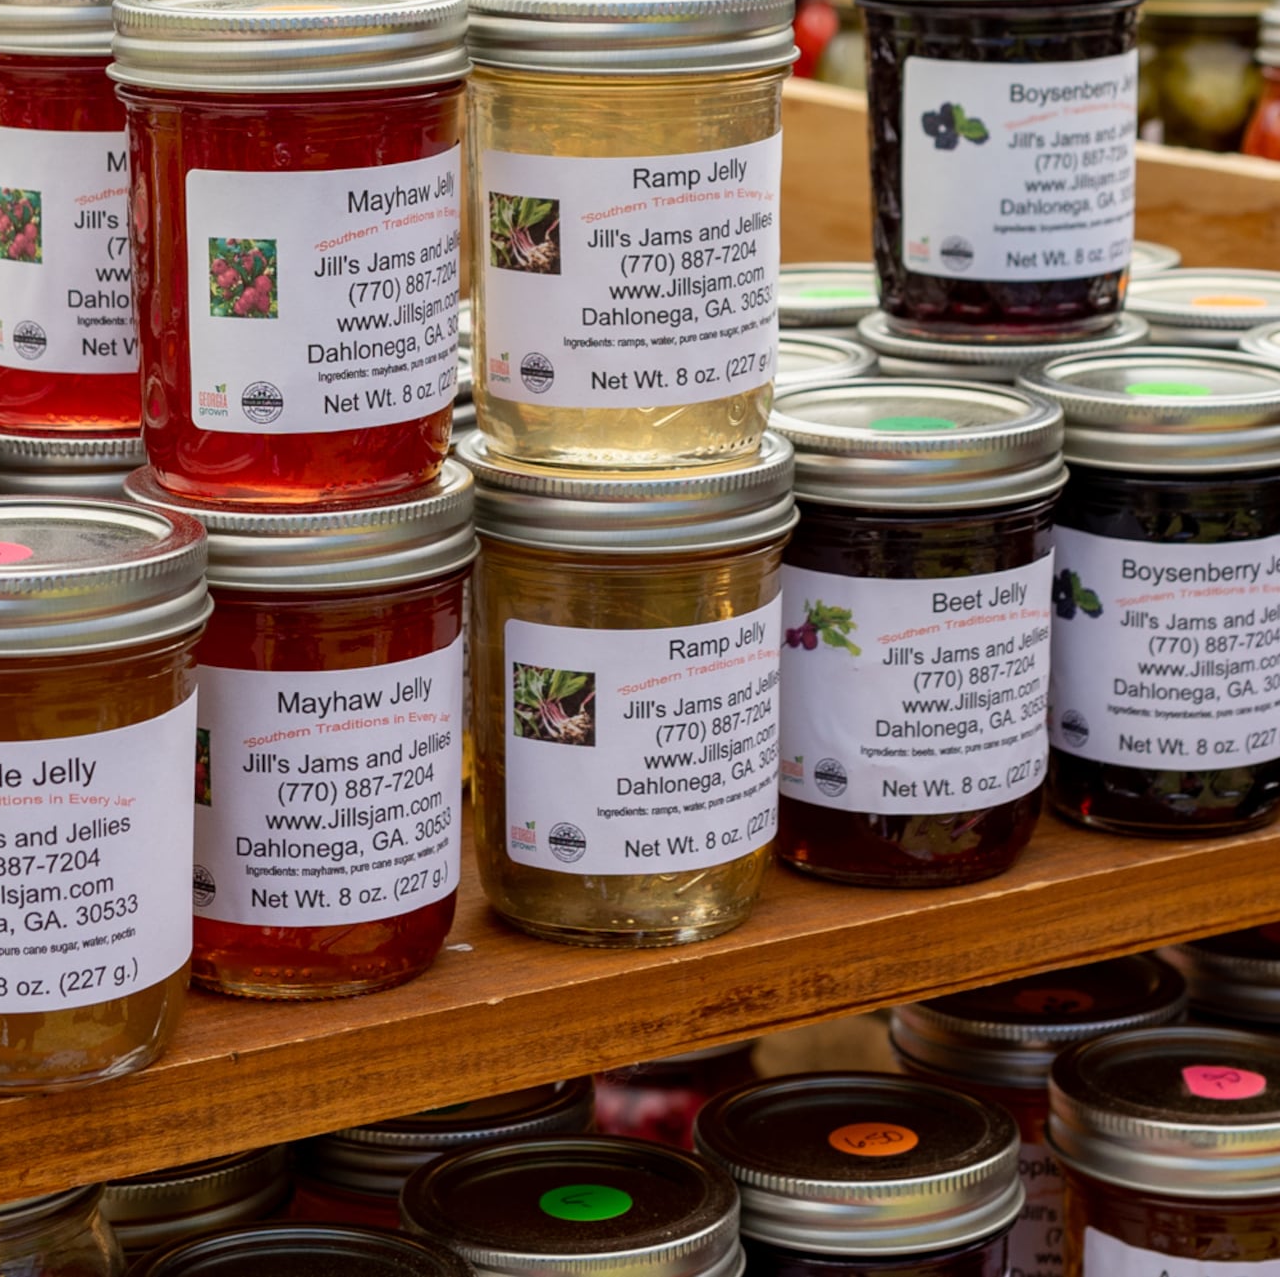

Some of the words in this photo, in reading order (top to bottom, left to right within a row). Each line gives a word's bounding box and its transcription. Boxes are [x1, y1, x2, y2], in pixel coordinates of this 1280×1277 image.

[1010, 78, 1118, 107] Boysenberry
[1008, 132, 1045, 149] Jill's
[1051, 129, 1091, 147] Jams
[1095, 127, 1116, 143] and
[633, 167, 701, 189] Ramp
[708, 158, 747, 182] Jelly
[348, 183, 431, 214] Mayhaw
[434, 172, 455, 198] Jelly
[1001, 197, 1093, 217] Dahlonega,
[74, 211, 119, 229] Jill's
[587, 229, 631, 248] Jill's
[638, 228, 693, 246] Jams
[699, 219, 730, 241] and
[735, 211, 772, 236] Jellies
[314, 255, 360, 277] Jill's
[367, 248, 415, 273] Jams
[420, 241, 442, 263] and
[620, 253, 674, 278] (770)
[681, 240, 756, 270] 887-7204
[609, 266, 764, 300] www.Jillsjam.com
[582, 304, 699, 326] Dahlonega,
[705, 297, 736, 318] GA.
[83, 339, 118, 356] Net
[308, 340, 420, 364] Dahlonega,
[424, 326, 445, 347] GA.
[592, 371, 628, 390] Net
[634, 369, 668, 389] Wt.
[676, 368, 688, 386] 8
[694, 366, 720, 384] oz.
[726, 355, 756, 382] (227
[198, 407, 229, 418] grown
[1122, 558, 1261, 586] Boysenberry
[933, 590, 982, 612] Beet
[988, 583, 1027, 607] Jelly
[1120, 610, 1160, 629] Jill's
[1166, 613, 1217, 631] Jams
[1224, 607, 1255, 627] and
[670, 636, 730, 660] Ramp
[735, 622, 766, 648] Jelly
[1149, 636, 1199, 657] (770)
[1205, 628, 1280, 654] 887-7204
[278, 690, 382, 718] Mayhaw
[390, 676, 432, 705] Jelly
[903, 679, 1040, 713] www.Jillsjam.com
[1114, 678, 1221, 705] Dahlonega,
[1227, 680, 1258, 699] GA.
[876, 719, 983, 738] Dahlonega,
[989, 711, 1016, 729] GA.
[243, 754, 290, 774] Jill's
[298, 754, 359, 774] Jams
[366, 744, 402, 768] and
[408, 731, 451, 760] Jellies
[33, 757, 96, 787] Jelly
[278, 781, 338, 806] (770)
[345, 763, 434, 798] 887-7204
[617, 770, 726, 796] Dahlonega,
[49, 795, 63, 805] in
[69, 794, 110, 807] Every
[266, 791, 442, 830] www.Jillsjam.com
[15, 826, 57, 846] and
[66, 817, 131, 844] Jellies
[236, 837, 364, 862] Dahlonega,
[372, 828, 408, 851] GA.
[24, 912, 67, 932] GA.
[76, 894, 138, 926] 30533
[23, 945, 48, 955] cane
[50, 940, 80, 955] sugar,
[82, 934, 109, 948] water,
[17, 979, 50, 996] oz.
[59, 966, 106, 998] (227
[113, 957, 138, 986] g.)
